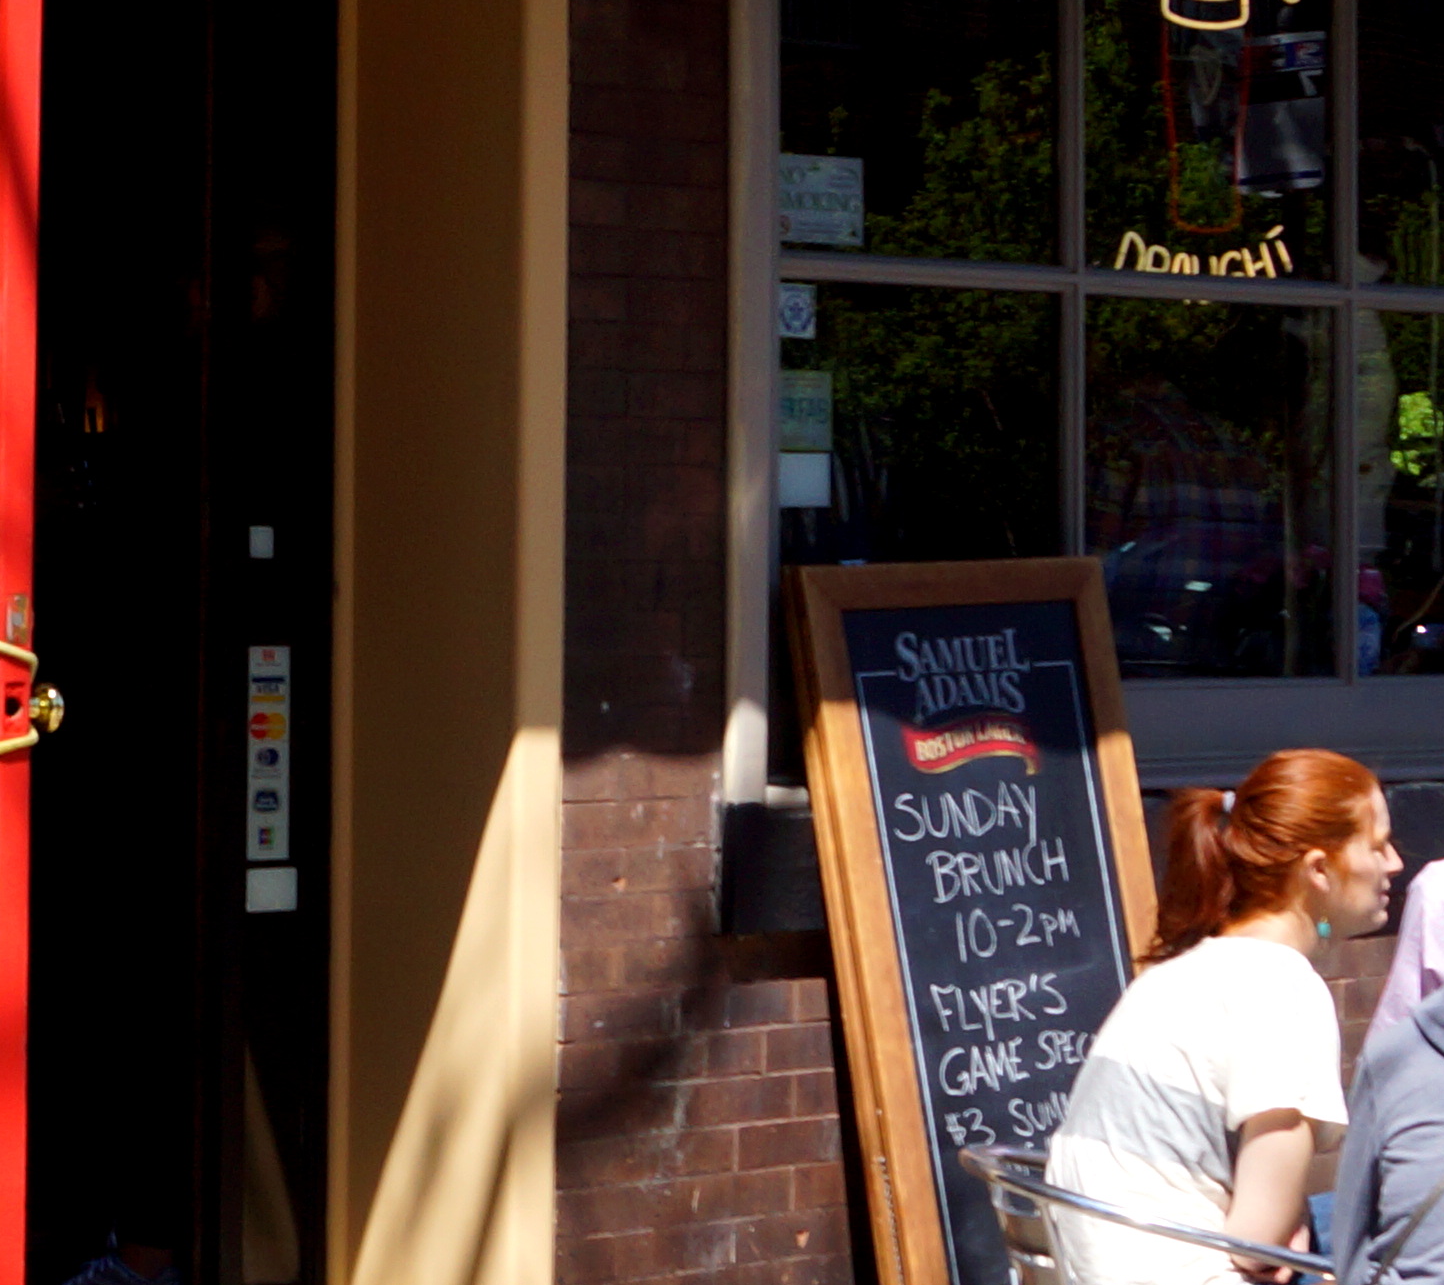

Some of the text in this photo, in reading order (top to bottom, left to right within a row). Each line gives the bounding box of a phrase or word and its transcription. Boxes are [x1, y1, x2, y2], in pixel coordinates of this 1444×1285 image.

[895, 627, 1031, 682] SAMUEL
[913, 670, 1026, 724] ADAMS
[914, 725, 975, 762] BOSTON
[893, 781, 1038, 842] SUNDAY
[925, 837, 1069, 904] BRUNCH
[929, 972, 1068, 1042] FLYER'S
[938, 1036, 1030, 1097] GAME
[944, 1107, 997, 1147] $3
